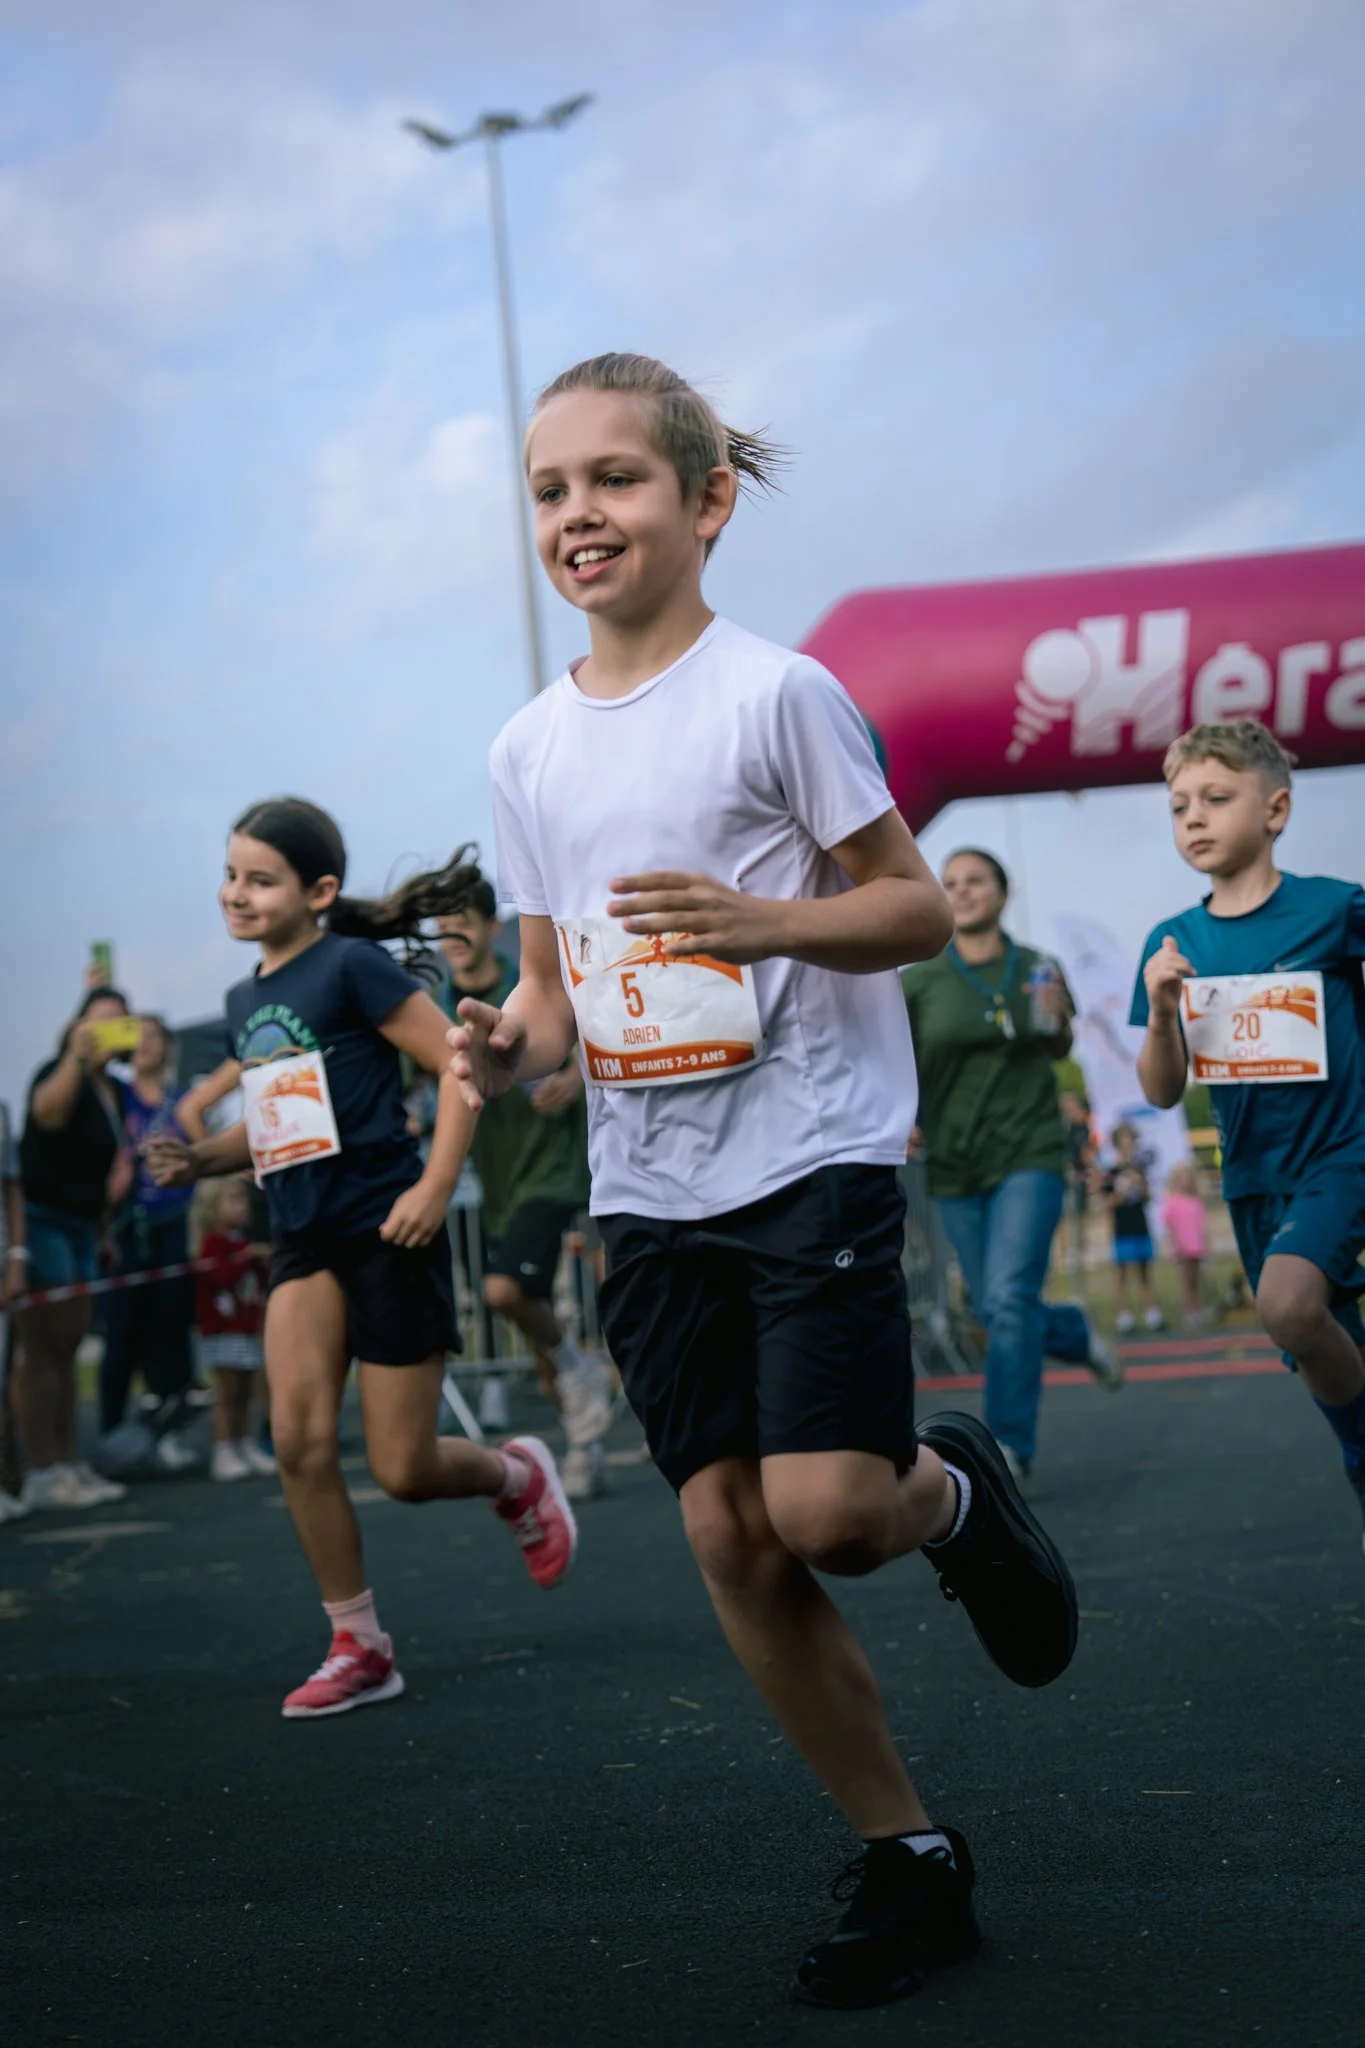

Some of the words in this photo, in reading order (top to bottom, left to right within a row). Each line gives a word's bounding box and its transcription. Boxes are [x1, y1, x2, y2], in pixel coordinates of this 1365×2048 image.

[620, 972, 644, 1018] 5
[623, 1025, 661, 1046] ADRIEN
[1232, 1012, 1261, 1041] 20
[631, 1057, 674, 1074] ENFANTS
[676, 1055, 698, 1069] 7-9
[701, 1049, 727, 1064] ANS
